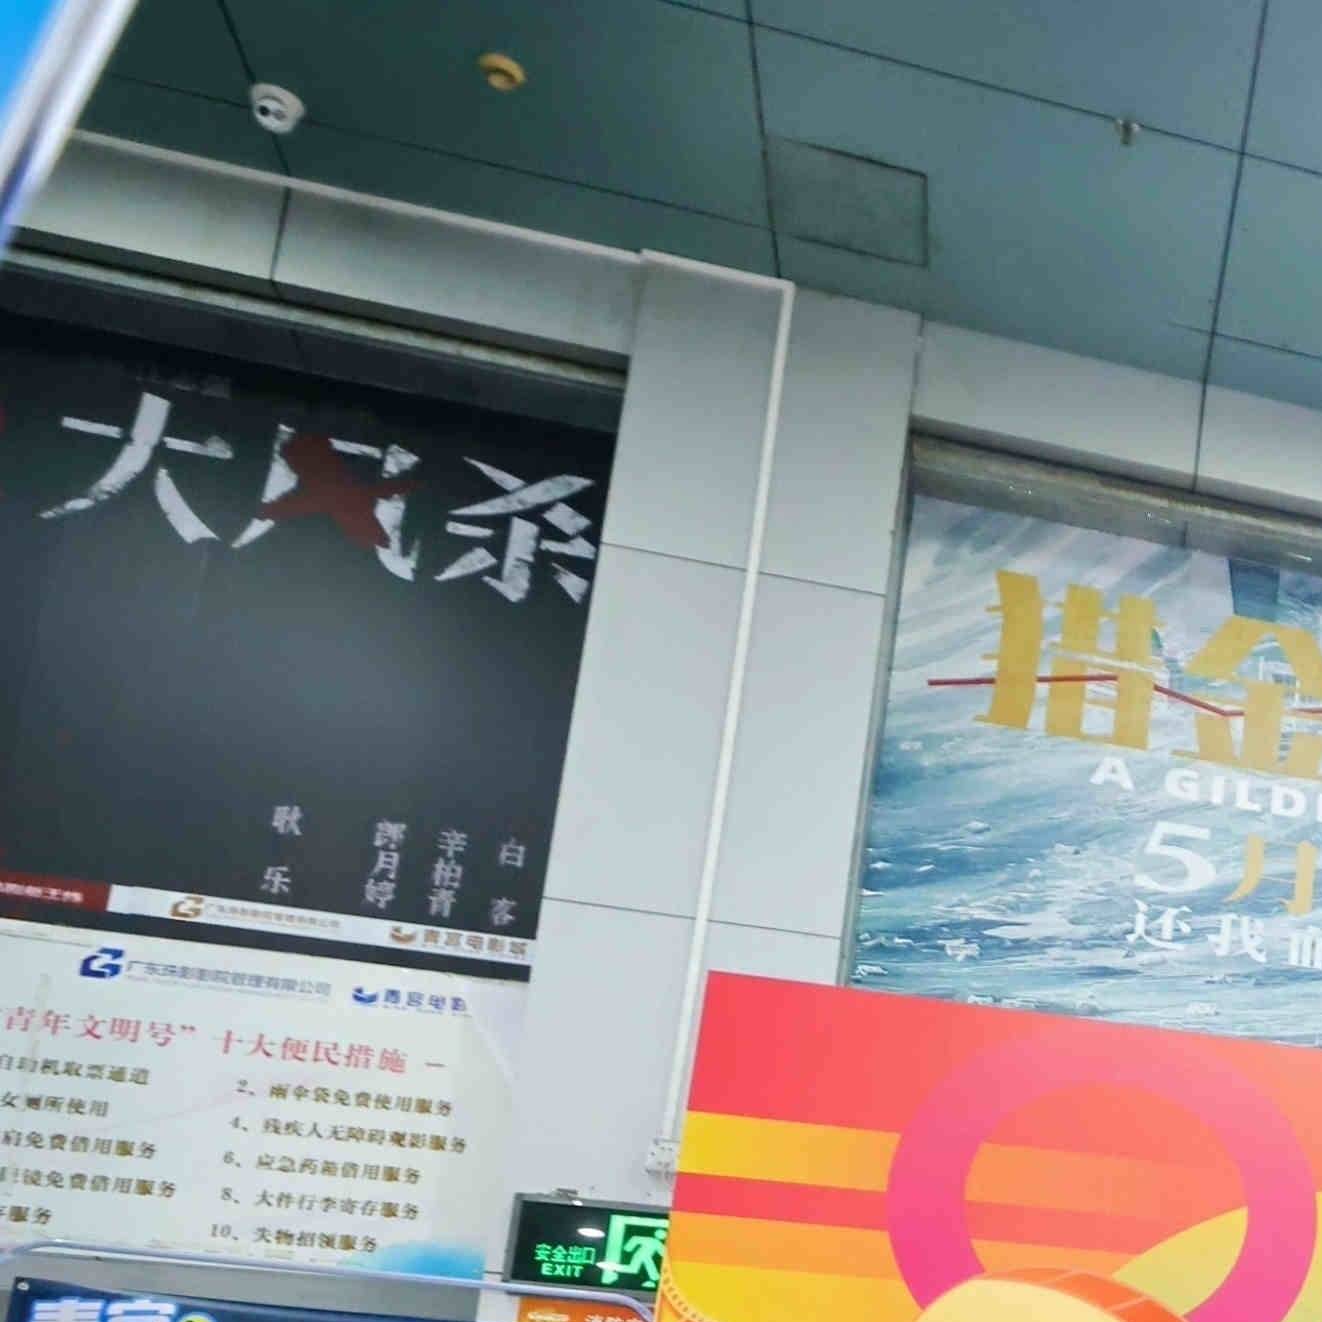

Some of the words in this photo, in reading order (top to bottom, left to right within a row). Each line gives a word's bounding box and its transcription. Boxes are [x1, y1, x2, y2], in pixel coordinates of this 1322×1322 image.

[1089, 757, 1134, 790] A
[534, 1243, 597, 1265] 安全出口
[541, 1263, 583, 1278] EXIT
